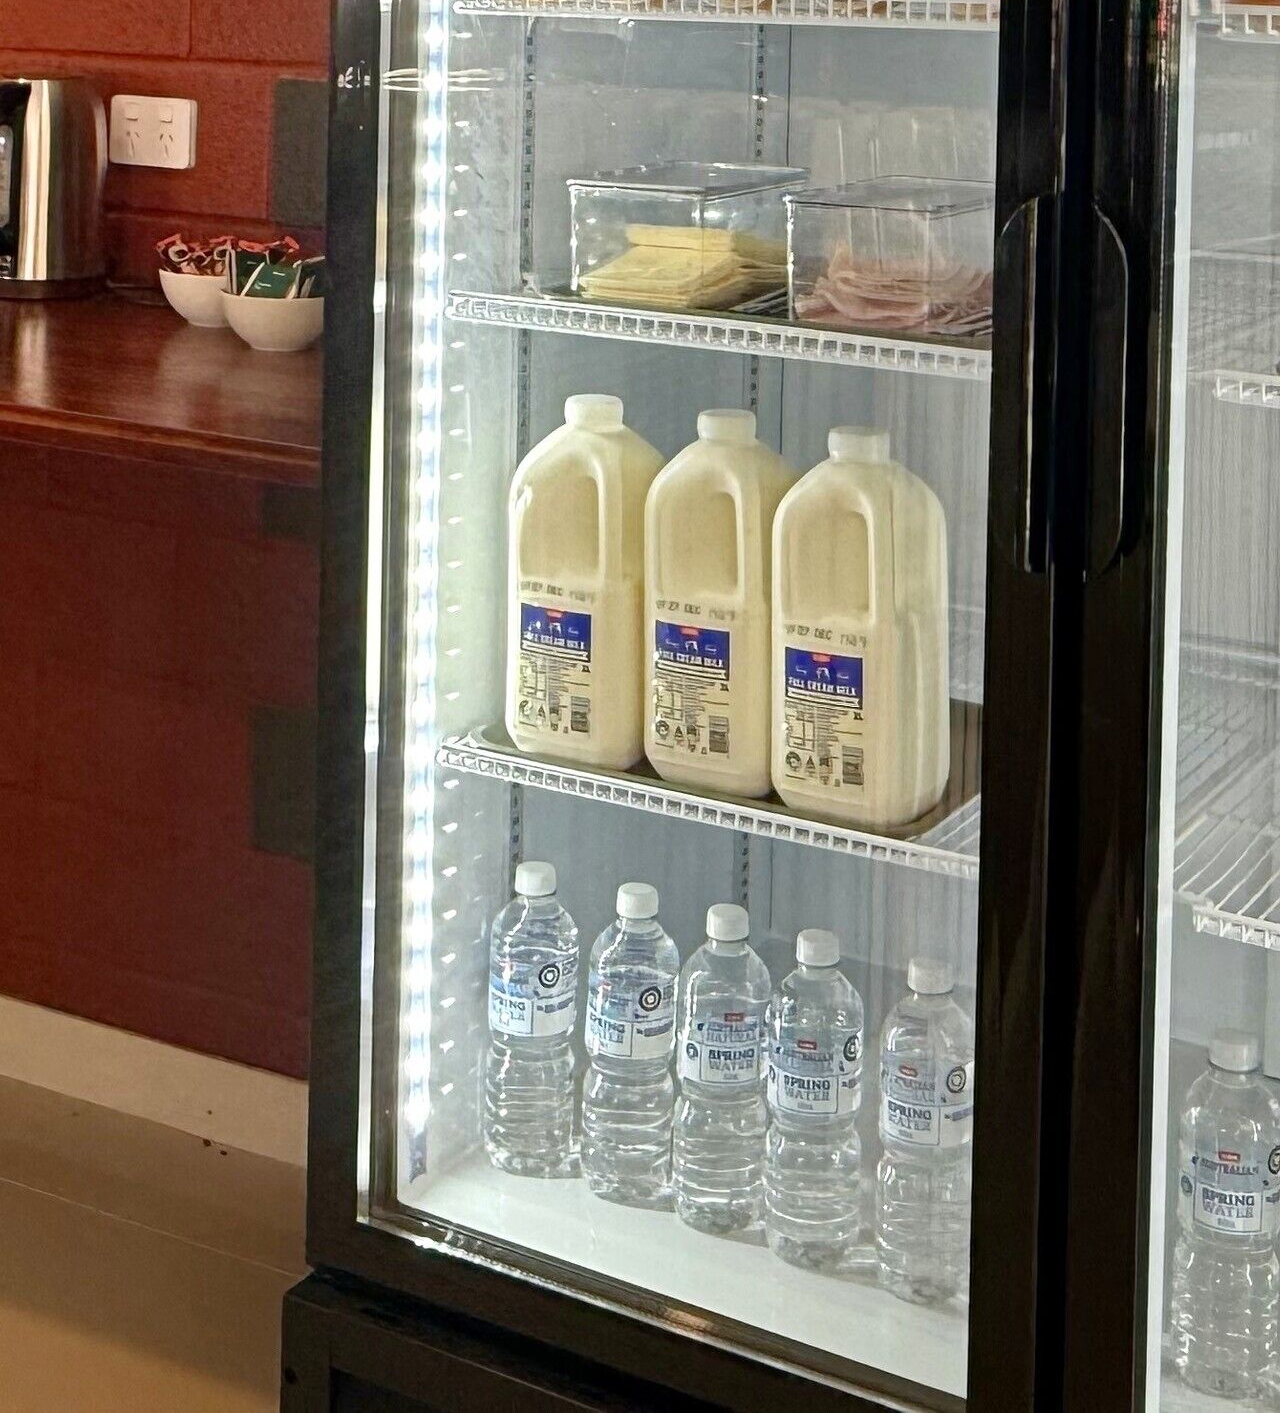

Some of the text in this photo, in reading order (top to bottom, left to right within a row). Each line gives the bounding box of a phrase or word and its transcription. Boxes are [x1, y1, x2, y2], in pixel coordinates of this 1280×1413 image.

[783, 1074, 831, 1091] SPRING
[1202, 1186, 1255, 1207] SPRING
[1203, 1200, 1254, 1219] WATER
